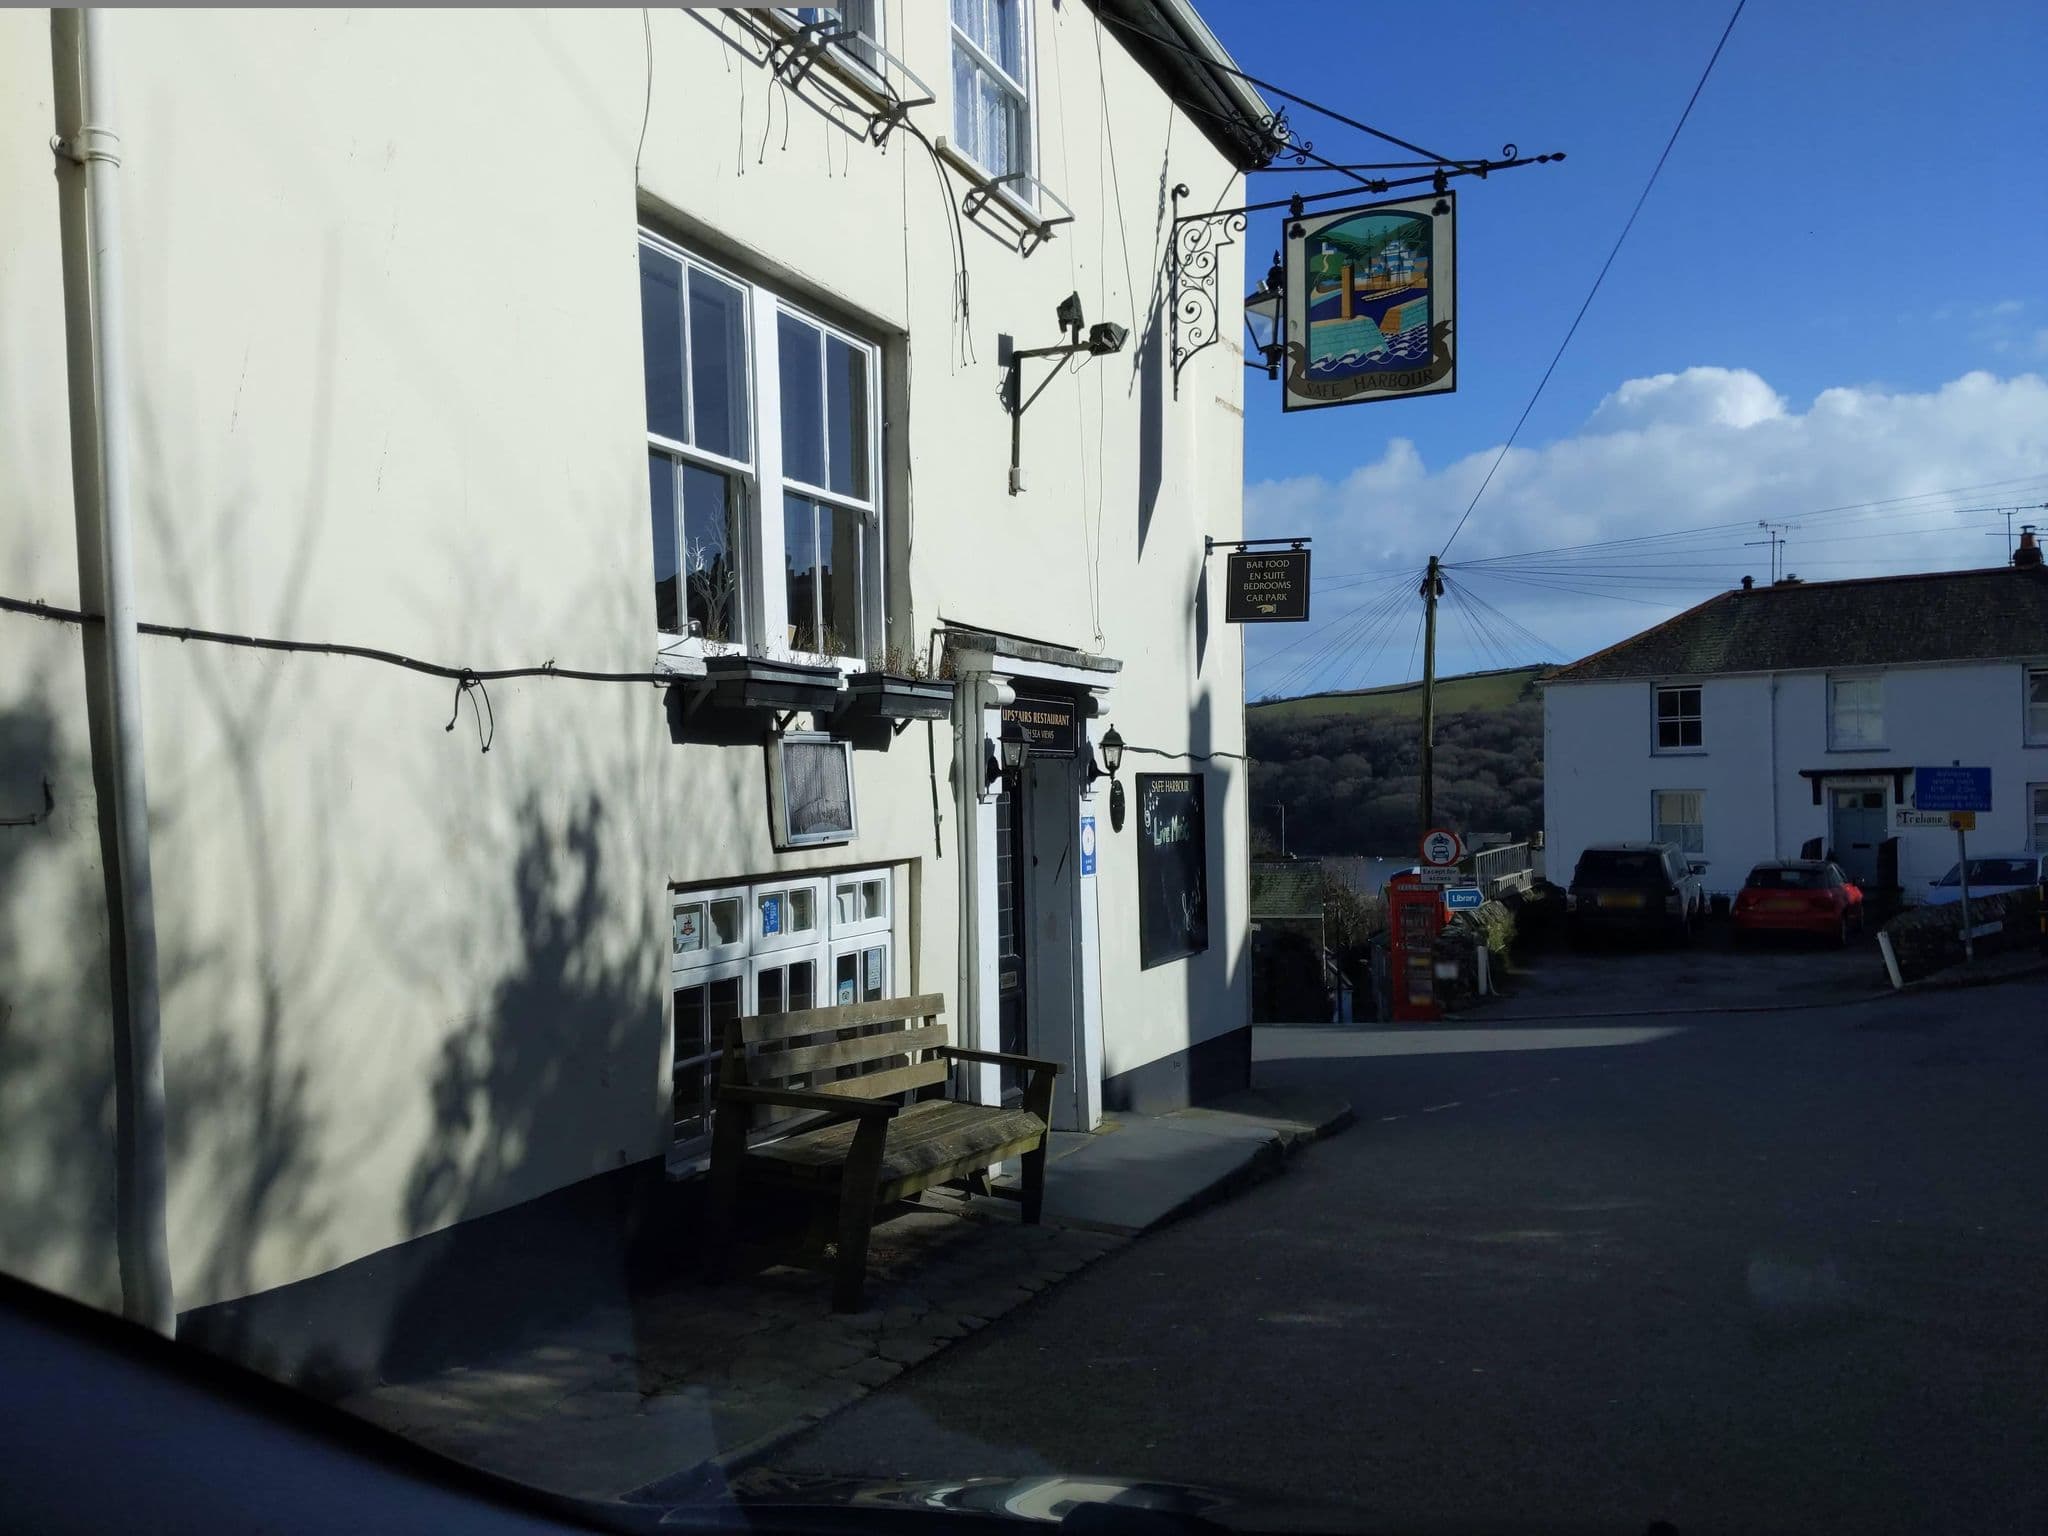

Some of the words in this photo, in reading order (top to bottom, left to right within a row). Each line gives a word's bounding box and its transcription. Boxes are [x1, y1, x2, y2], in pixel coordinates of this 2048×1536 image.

[1304, 383, 1342, 397] SAFE
[1354, 369, 1434, 391] HARBOUR
[1246, 561, 1264, 569] BAR
[1265, 559, 1290, 568] FOOD
[1249, 572, 1261, 580] EN
[1263, 571, 1286, 580] SUITE
[1243, 581, 1291, 590] BEDROOMS
[1246, 594, 1263, 602] CAR
[1265, 593, 1288, 601] PARK
[1002, 709, 1032, 723] UPSTAIRS
[1033, 712, 1070, 727] RESTAURANT
[1041, 730, 1055, 740] VIEWS
[1151, 780, 1165, 793] SAFE
[1165, 780, 1191, 792] HARBOUR
[1153, 816, 1170, 846] Live
[1452, 894, 1478, 904] Library
